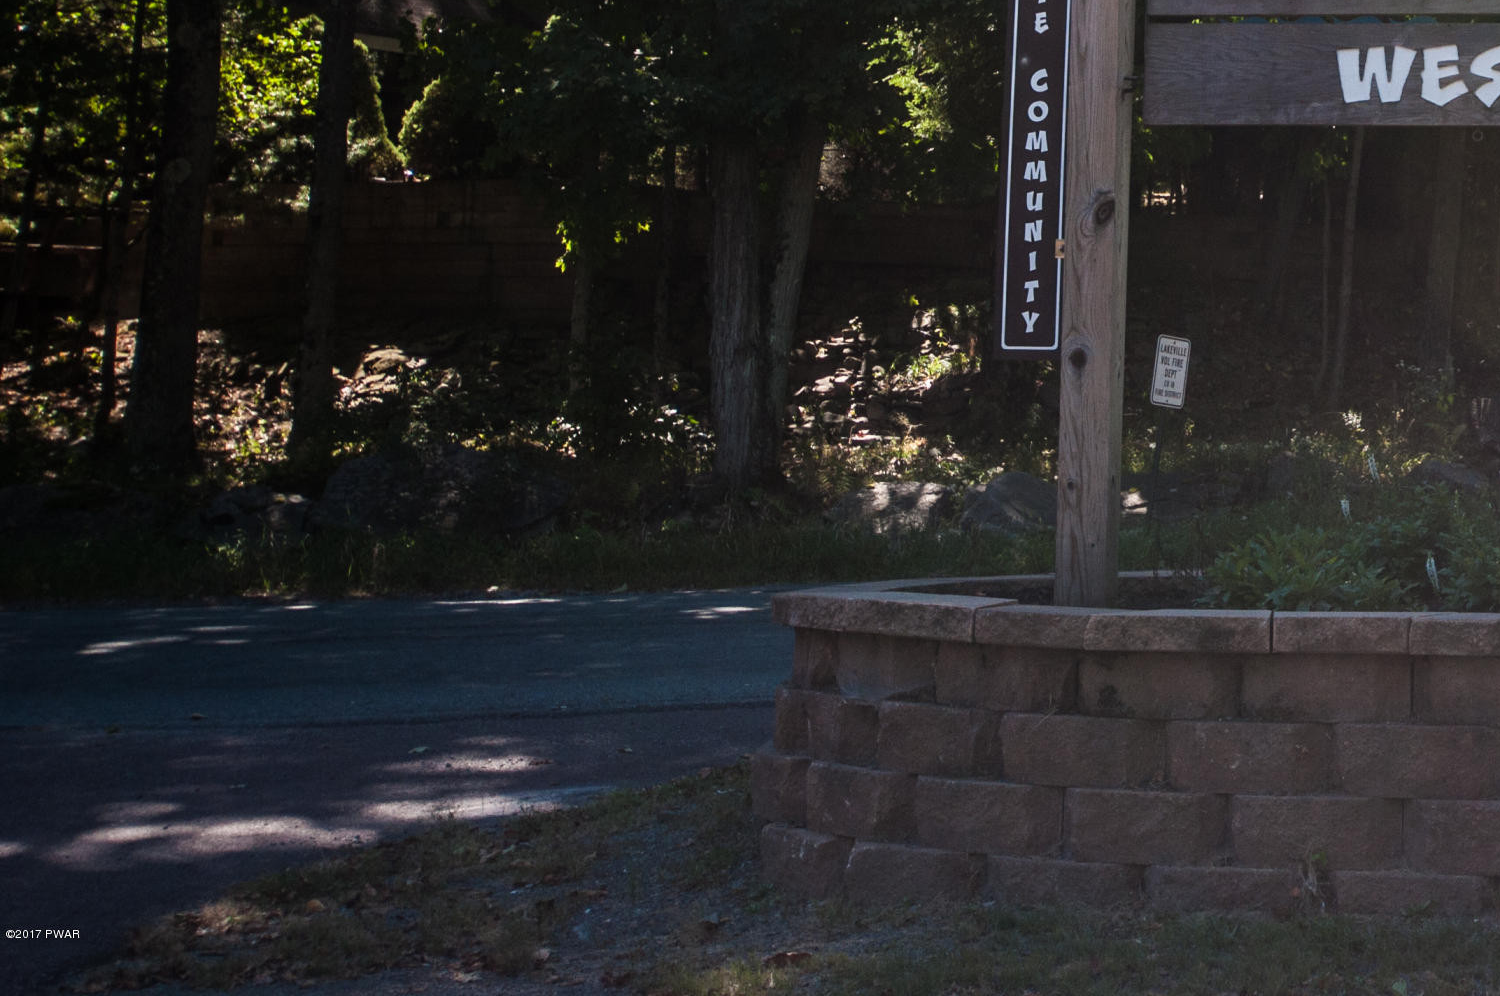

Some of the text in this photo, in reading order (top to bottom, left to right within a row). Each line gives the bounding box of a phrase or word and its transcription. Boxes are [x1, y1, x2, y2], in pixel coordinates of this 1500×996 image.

[1021, 68, 1049, 334] COMMUNITY
[1160, 344, 1187, 356] LAKEVILLE
[1172, 358, 1184, 368] FIRE
[1164, 368, 1177, 379] DEPT
